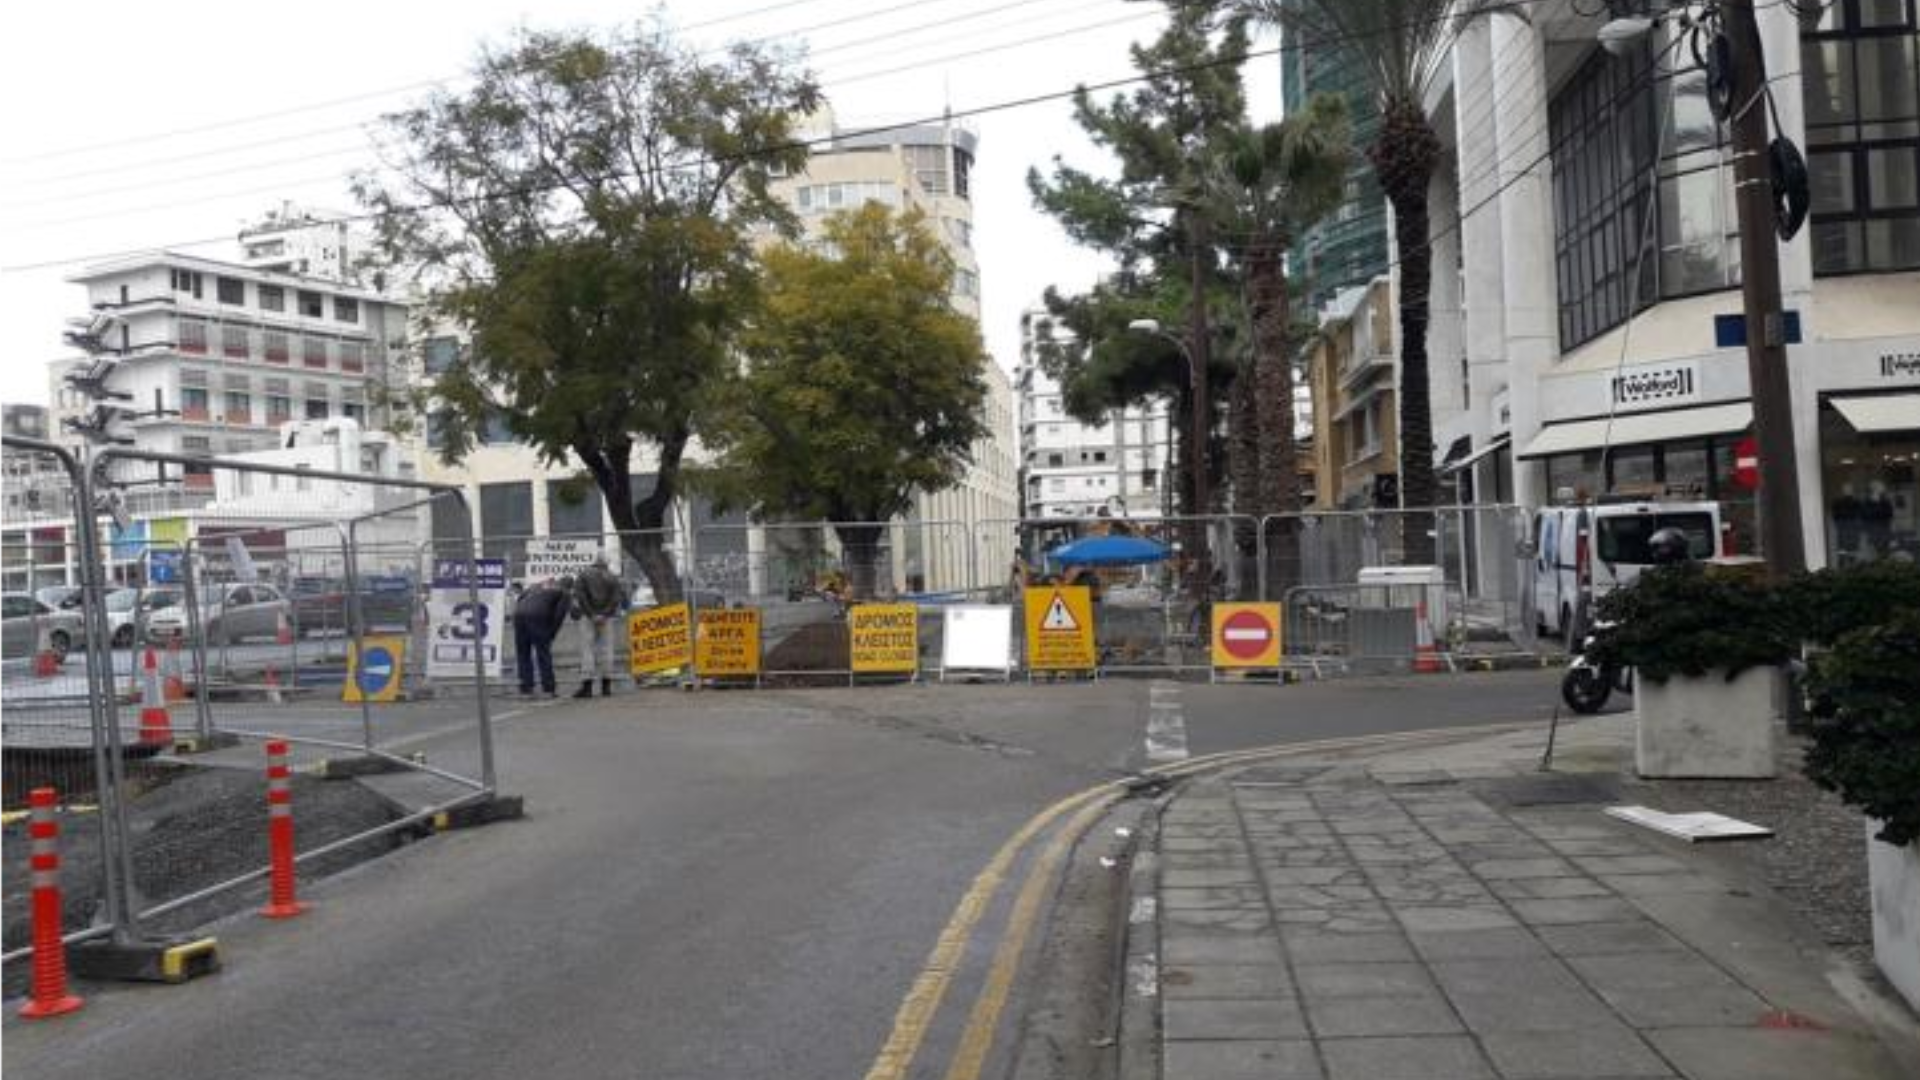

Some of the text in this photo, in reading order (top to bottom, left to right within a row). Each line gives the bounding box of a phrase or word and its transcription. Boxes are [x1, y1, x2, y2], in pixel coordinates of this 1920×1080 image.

[1626, 376, 1678, 394] Wolford
[546, 541, 576, 551] NEW
[631, 610, 685, 634] ΔΡΟΜΟΣ
[855, 612, 914, 629] ΔΡΟΜΟΣ
[633, 628, 686, 651] ΚΛΕΙΣΤΟΣ
[855, 631, 914, 647] ΚΛΕΙΣΤΟΣ
